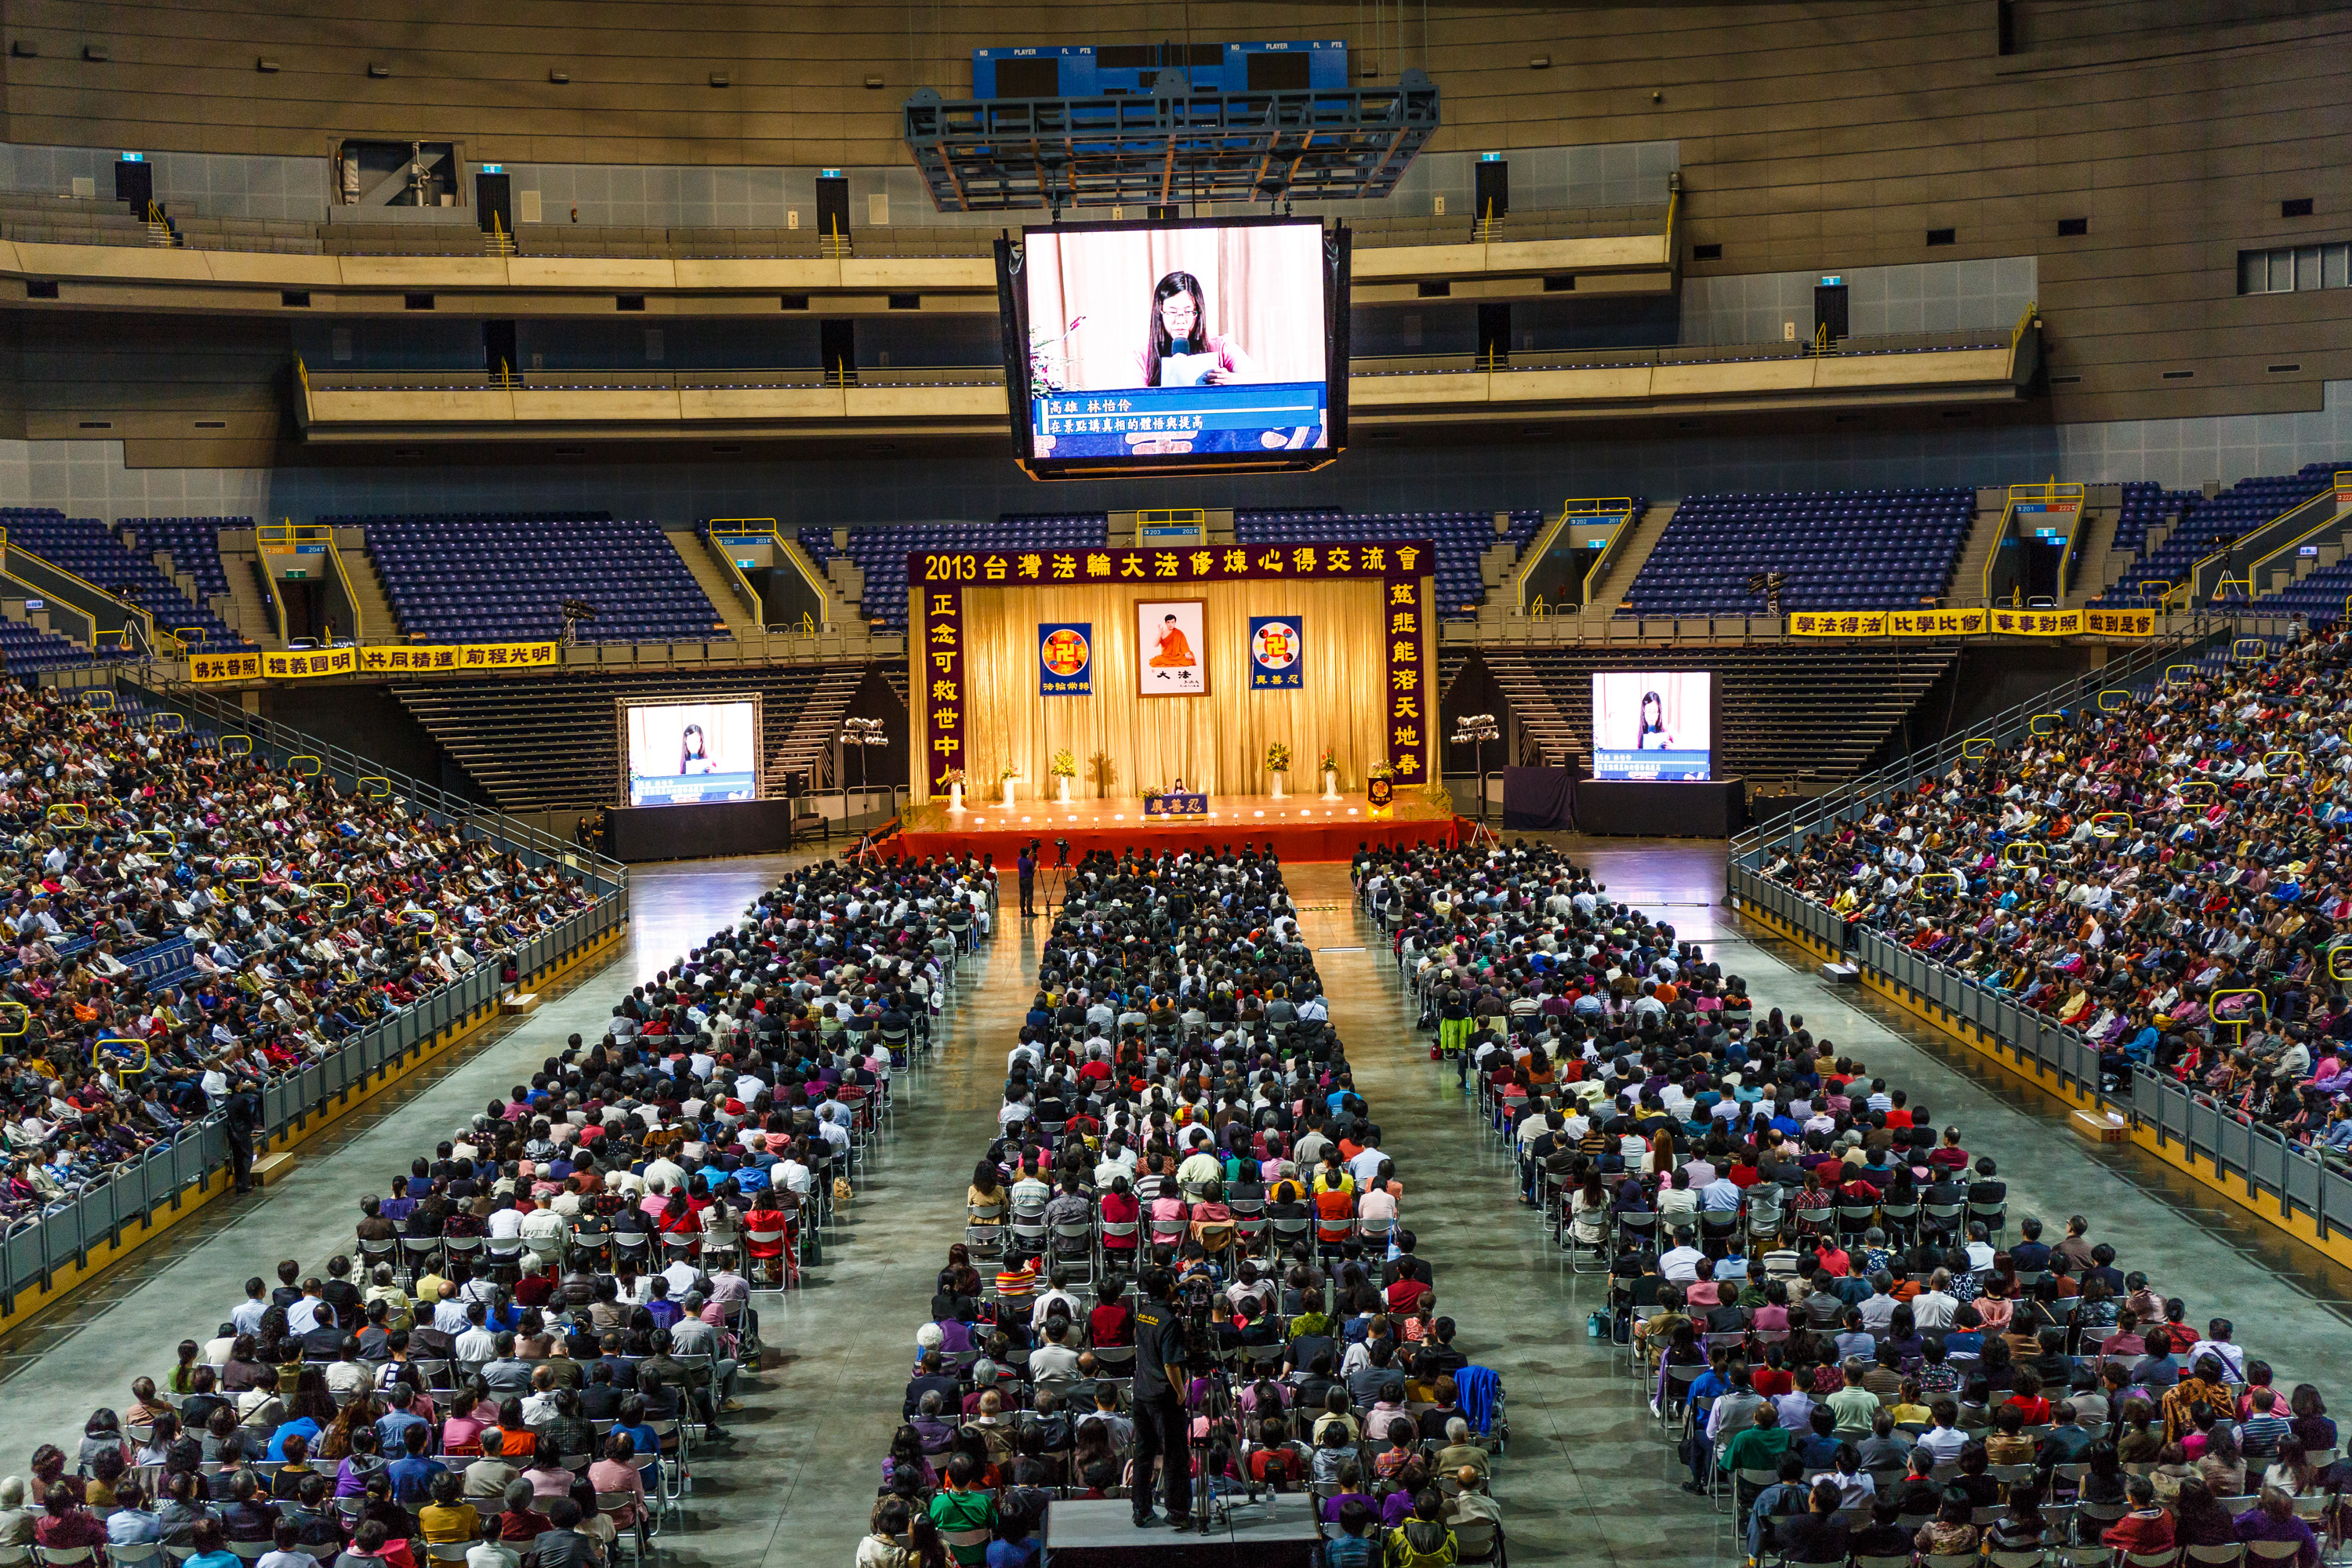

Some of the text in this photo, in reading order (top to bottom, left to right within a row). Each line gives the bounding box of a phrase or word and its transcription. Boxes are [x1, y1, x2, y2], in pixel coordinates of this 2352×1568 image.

[1050, 398, 1133, 414] 高雄 林怡伶
[1796, 616, 1882, 633] 學法得法
[1894, 615, 1980, 633] 比學比修
[1997, 614, 2078, 633] 事事對照
[2089, 614, 2151, 633] 做到是修
[268, 652, 350, 675] 禮義圓明
[366, 651, 455, 669] 共同精進
[466, 645, 551, 665] 前程光明
[195, 658, 257, 679] 佛光普照
[1254, 674, 1299, 685] 真善忍
[1390, 583, 1421, 775] 慈悲能溶天地春
